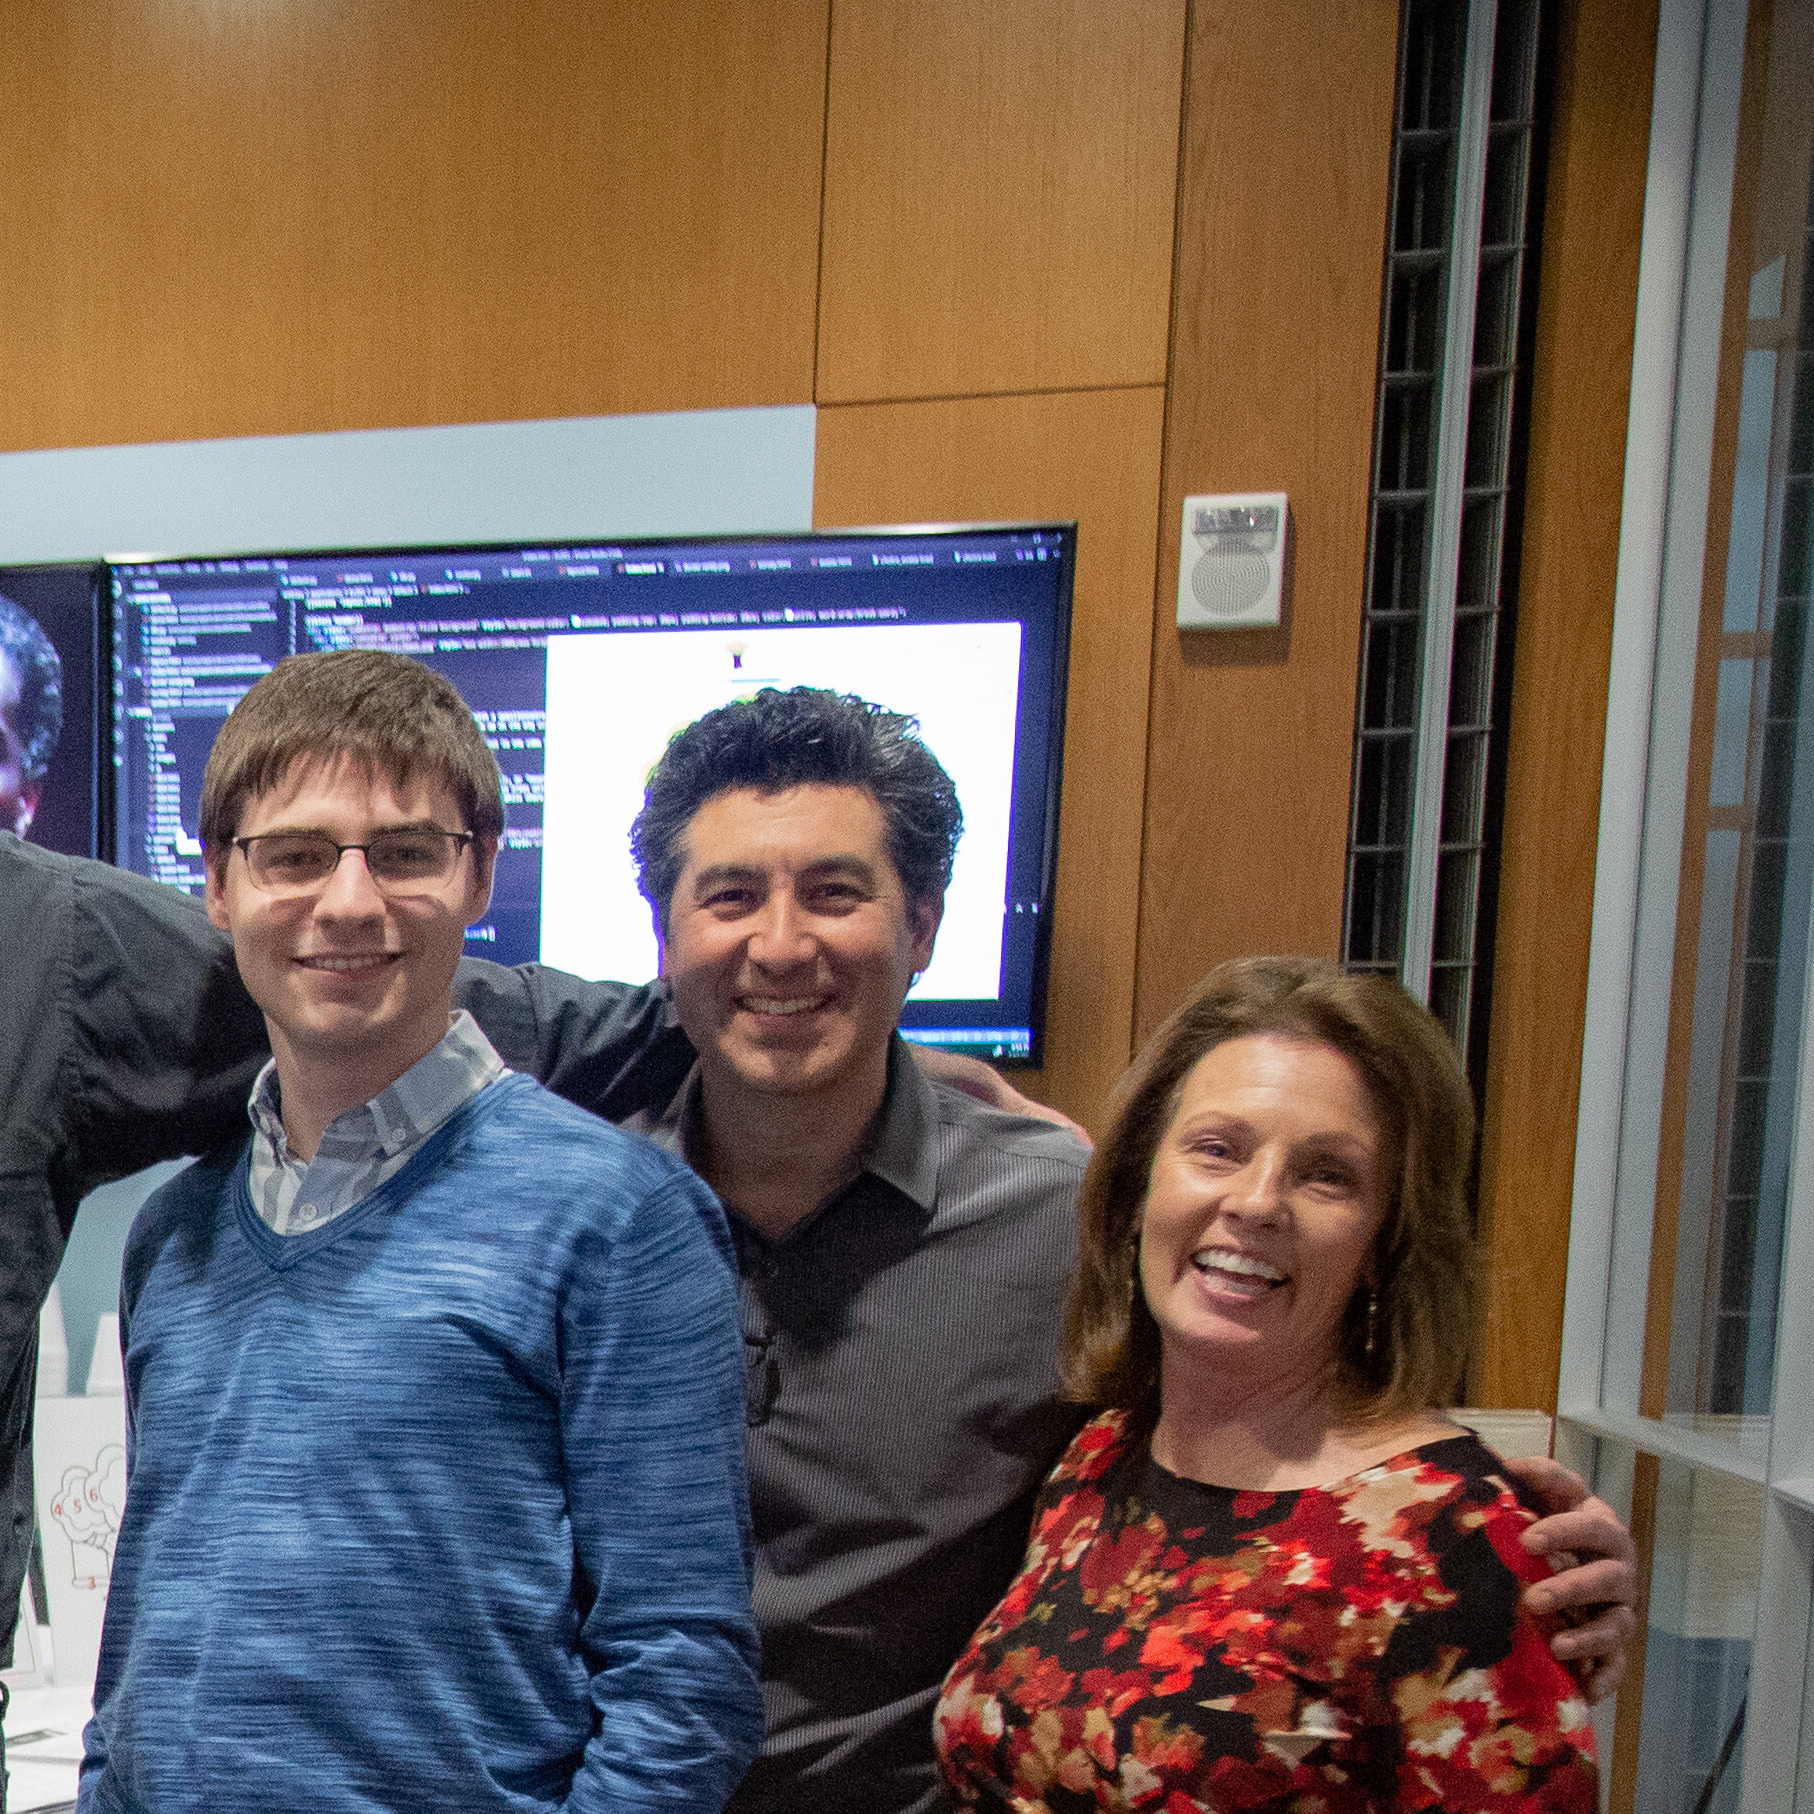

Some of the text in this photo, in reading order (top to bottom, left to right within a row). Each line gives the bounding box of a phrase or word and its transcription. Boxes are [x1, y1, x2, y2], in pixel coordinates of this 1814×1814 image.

[89, 1488, 98, 1503] 6
[54, 1499, 82, 1516] 4 5
[88, 1576, 97, 1590] 3
